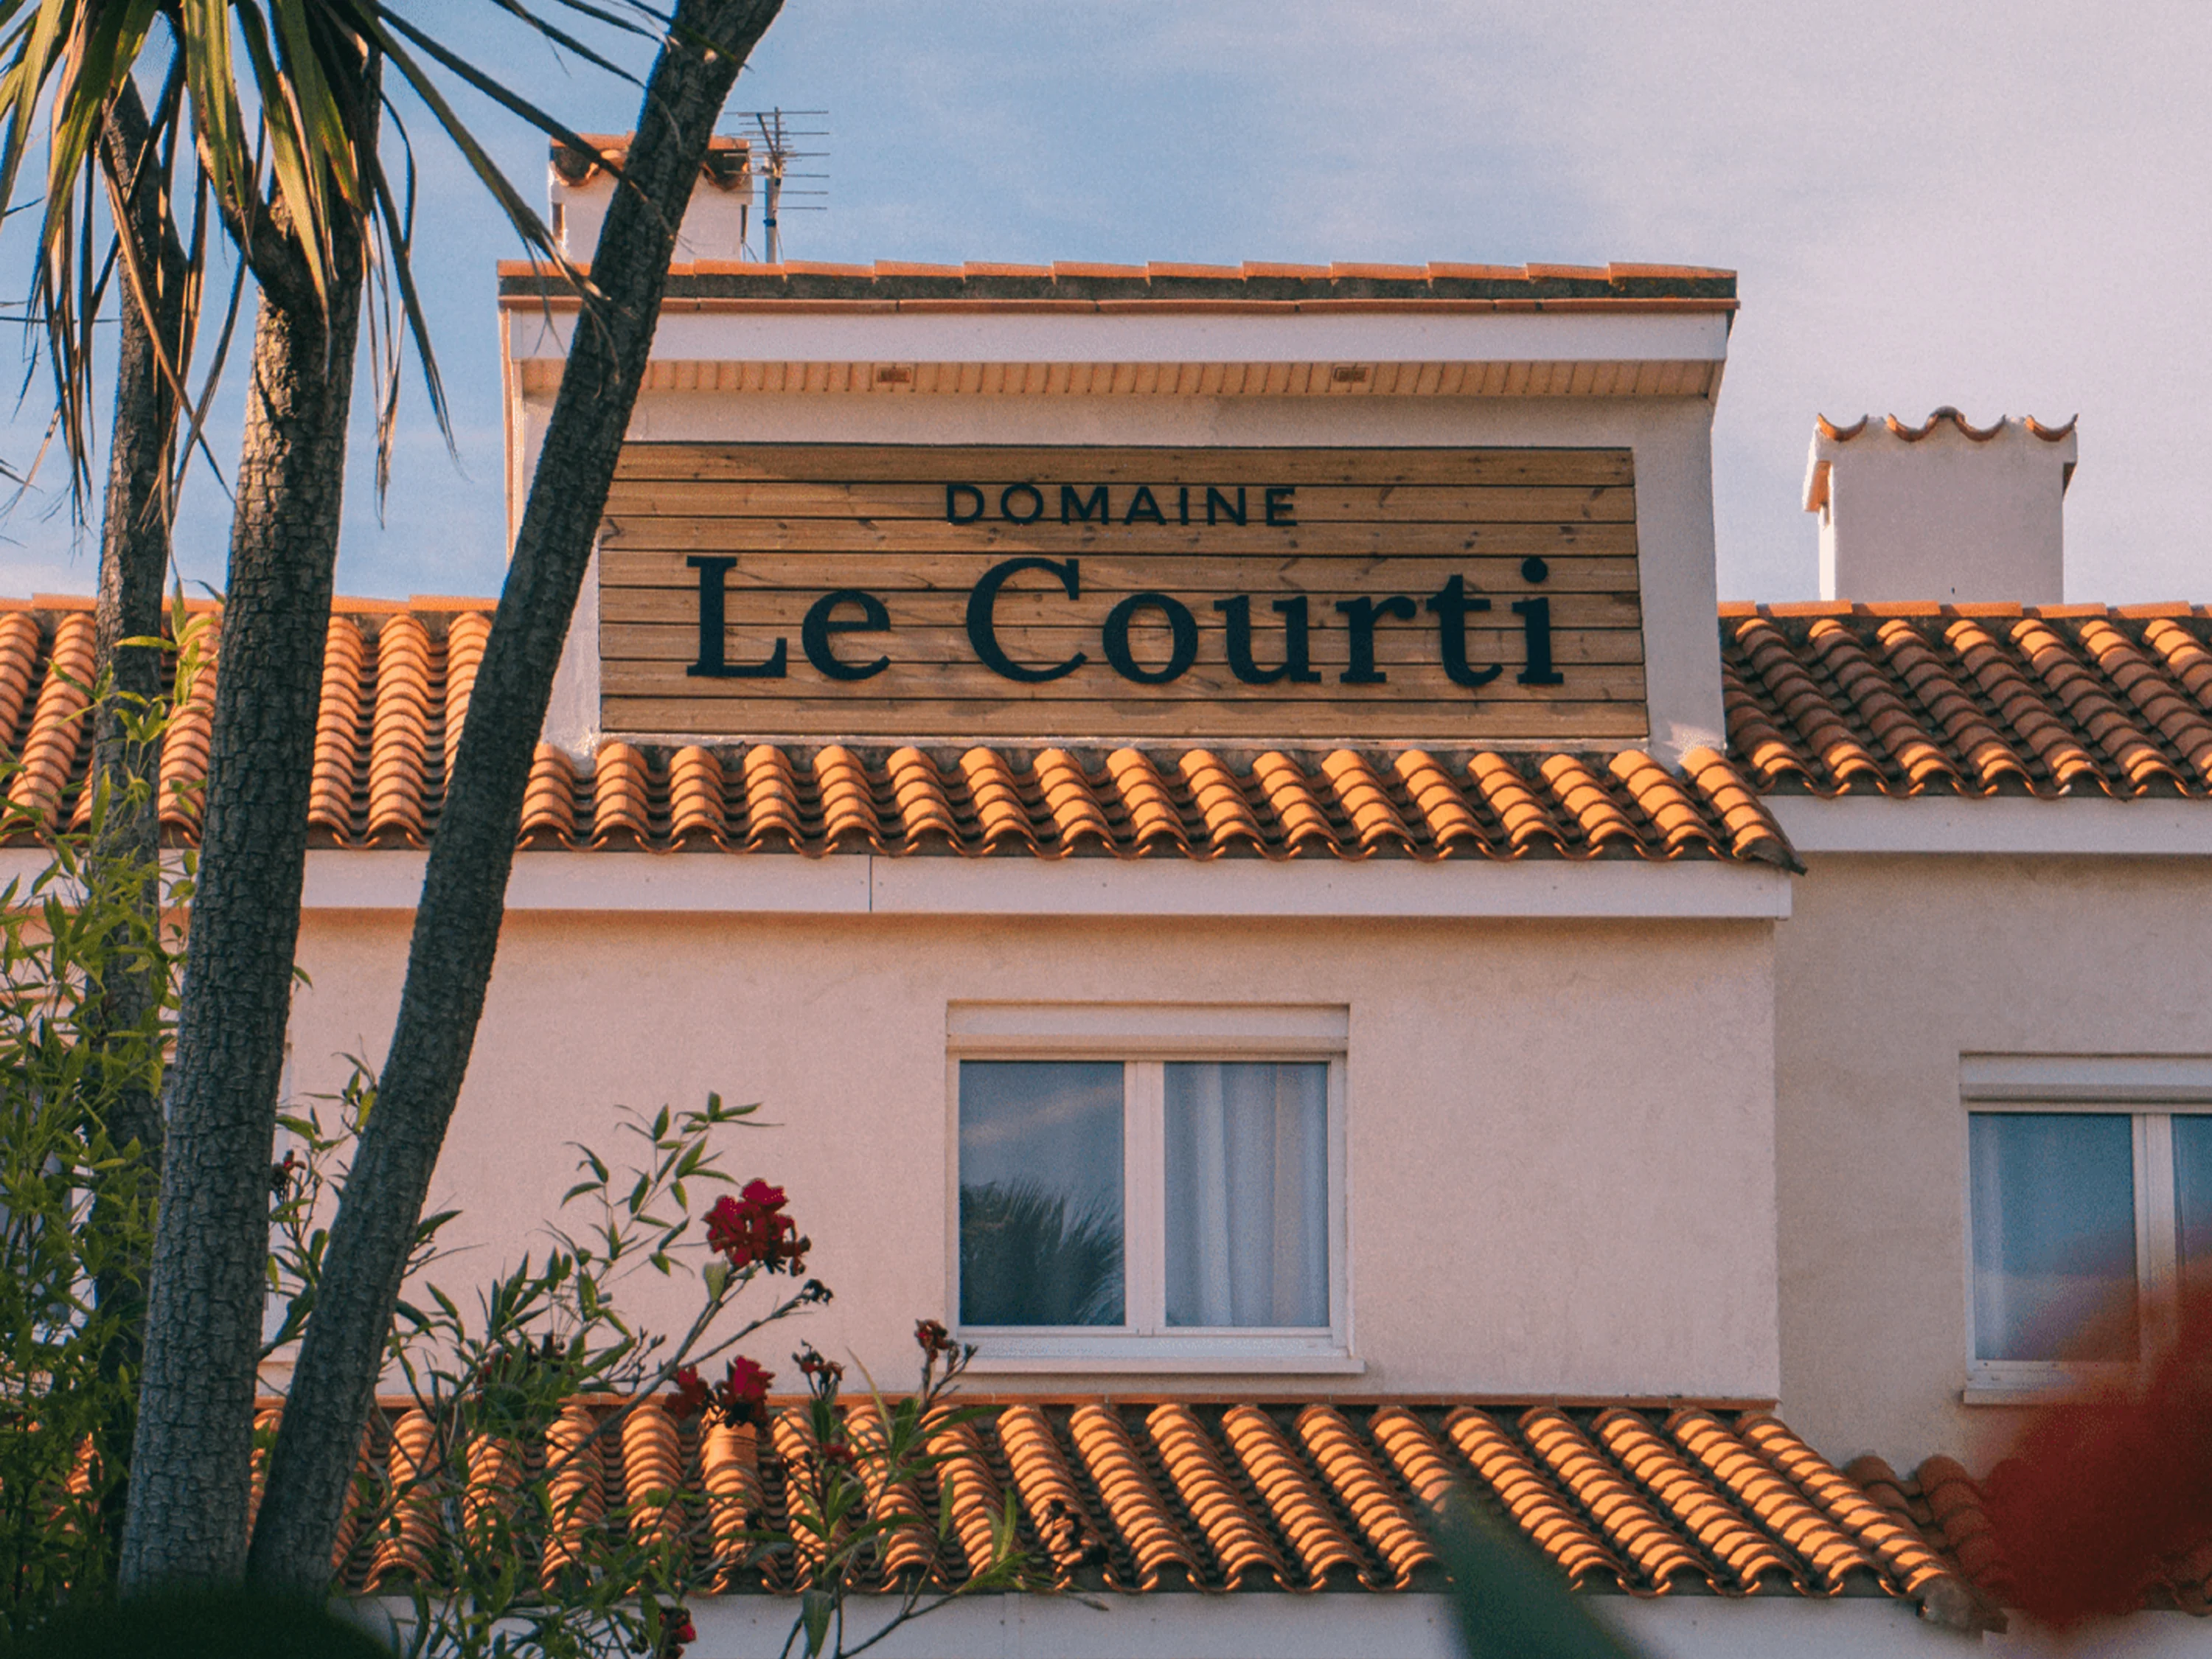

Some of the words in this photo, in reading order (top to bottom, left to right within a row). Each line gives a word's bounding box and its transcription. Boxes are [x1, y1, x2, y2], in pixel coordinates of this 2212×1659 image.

[945, 482, 1298, 528] DOMAINE
[686, 555, 891, 682] Le
[965, 555, 1565, 689] Courti
